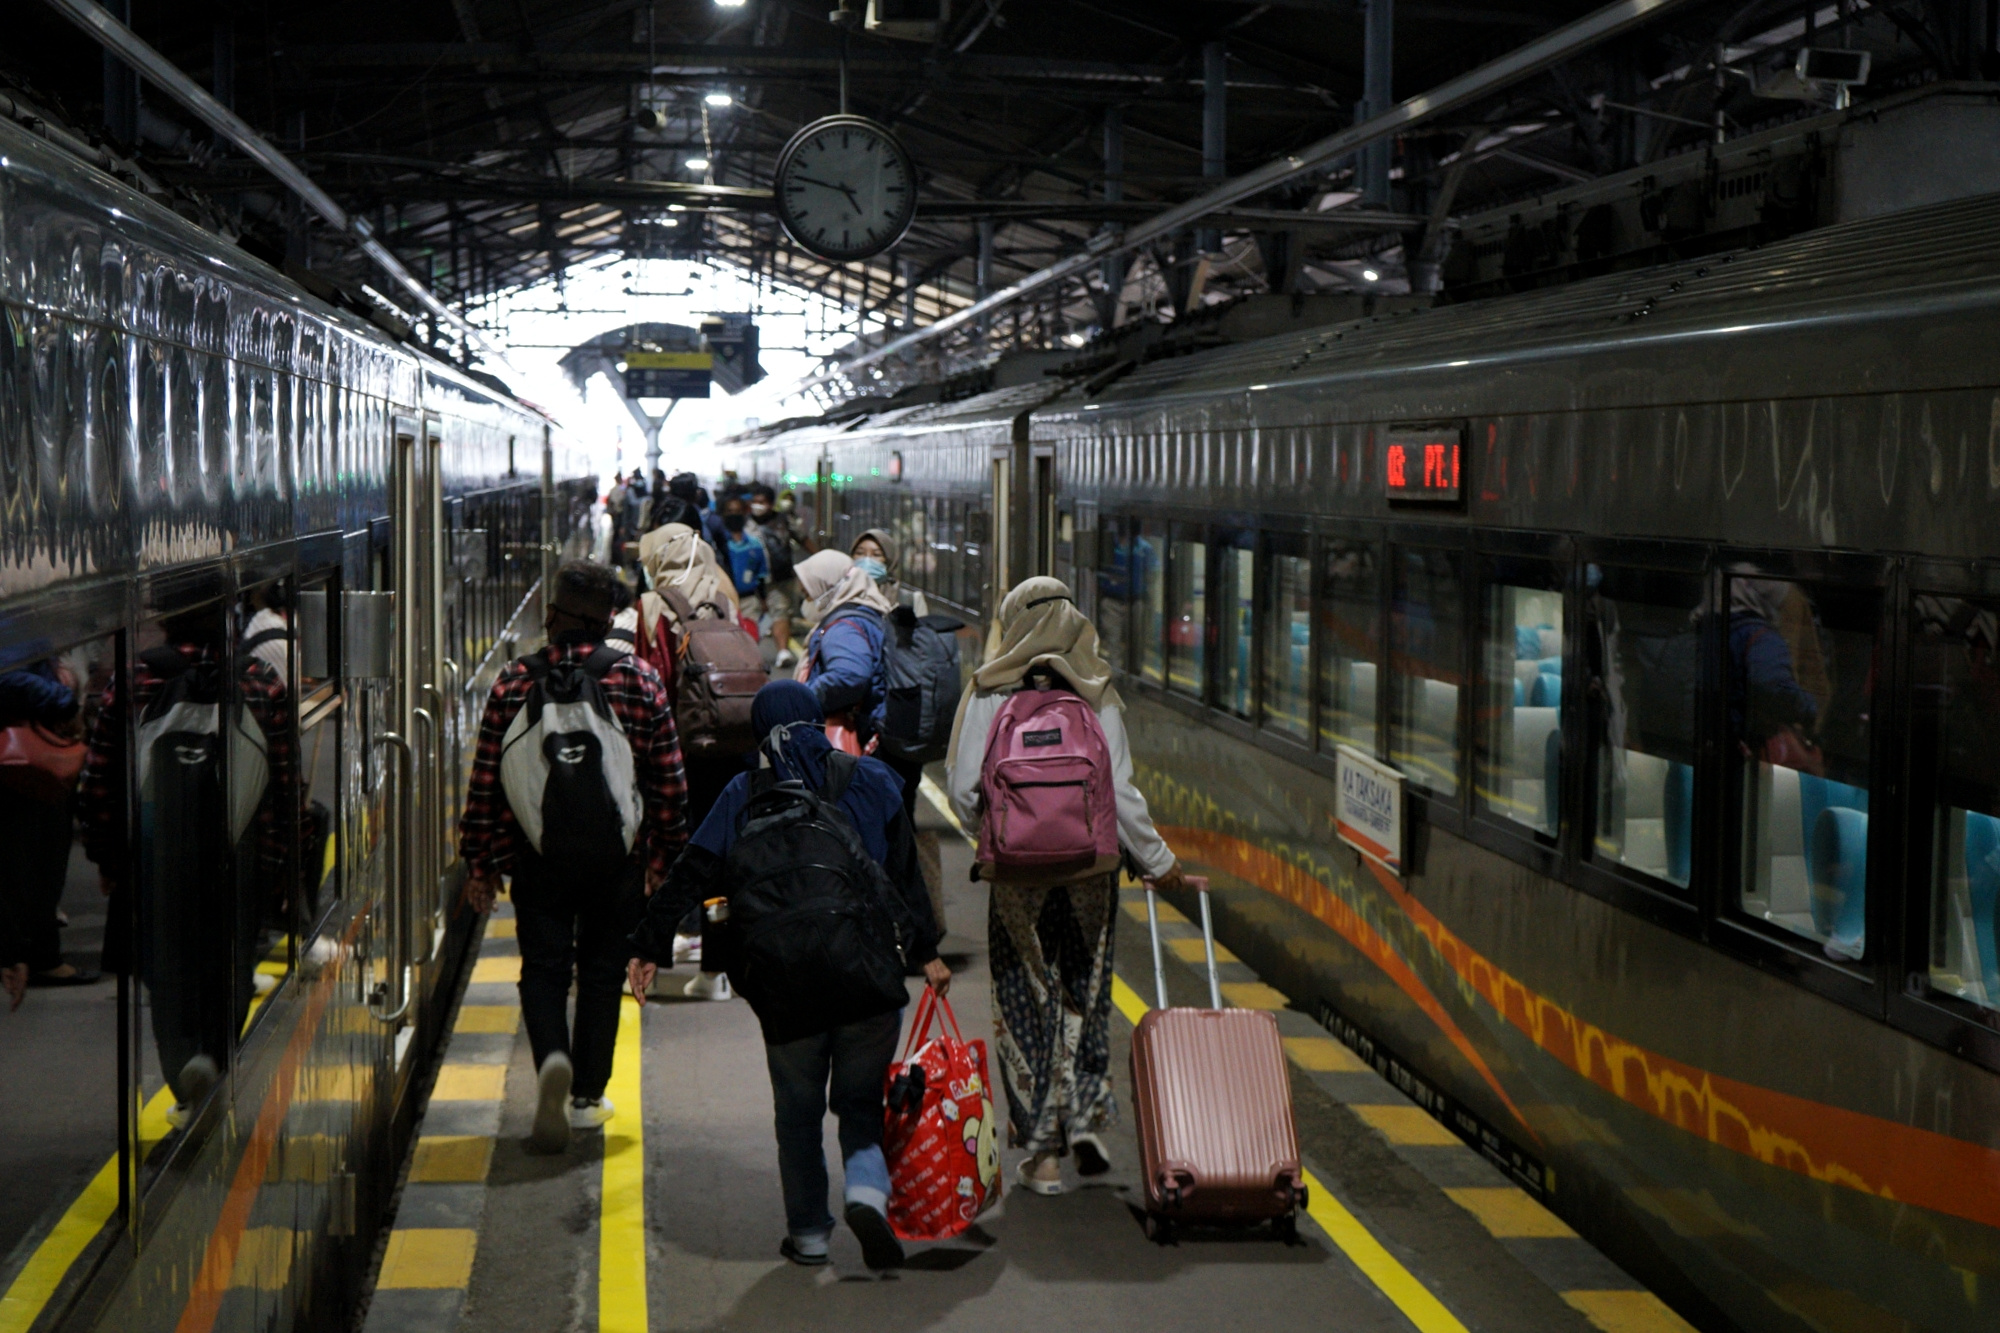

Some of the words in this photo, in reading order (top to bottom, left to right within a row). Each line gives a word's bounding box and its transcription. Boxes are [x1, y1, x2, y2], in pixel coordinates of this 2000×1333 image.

[1343, 766, 1354, 797] KA
[1355, 772, 1392, 817] TAKSAKA
[918, 1134, 939, 1151] WORLD
[914, 1167, 933, 1182] WORLD
